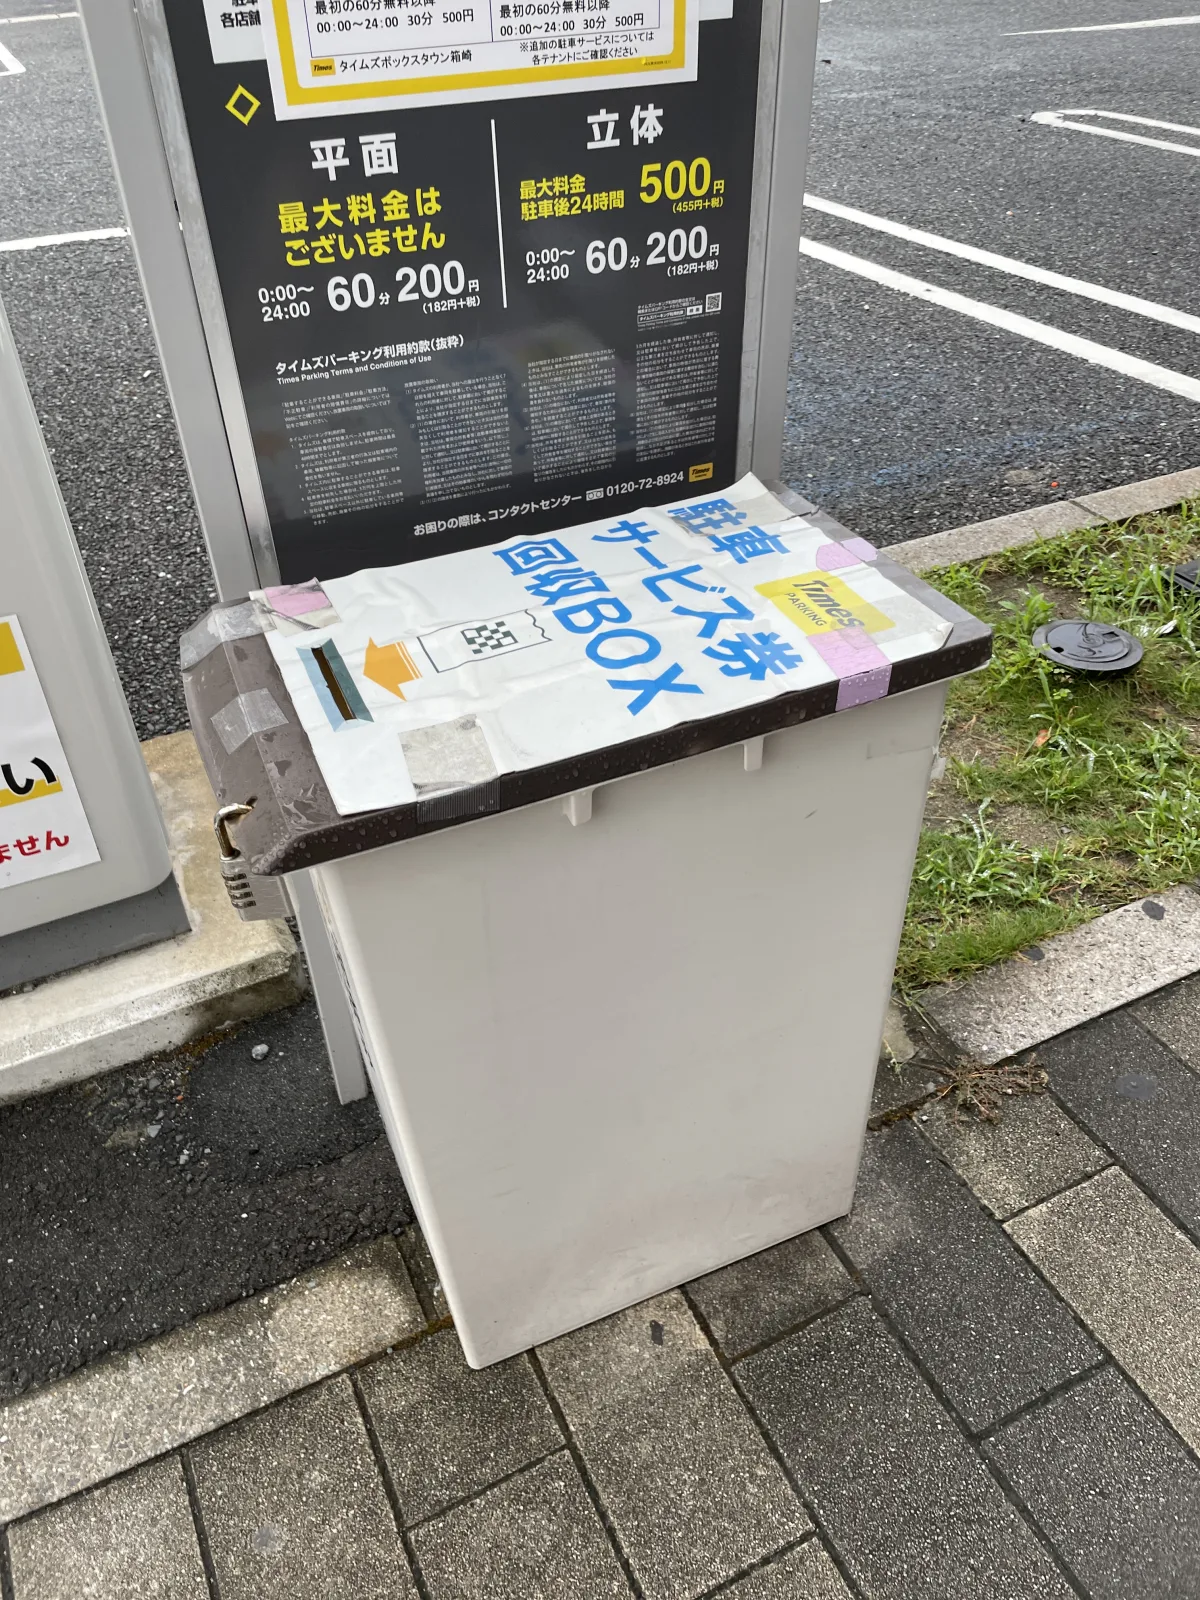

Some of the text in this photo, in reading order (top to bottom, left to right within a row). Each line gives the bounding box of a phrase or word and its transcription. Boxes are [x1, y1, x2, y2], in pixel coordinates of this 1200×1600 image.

[407, 12, 433, 26] 30分
[442, 9, 474, 23] 500円
[583, 15, 607, 30] 30分
[615, 13, 644, 27] 500円
[339, 49, 473, 73] タイムズボックスタウン箱崎
[531, 48, 638, 65] 各テナントにご確認ください
[586, 103, 664, 150] 立体
[309, 132, 399, 182] 平面
[519, 173, 586, 200] 最大料金
[278, 186, 442, 234] 最大料金は
[520, 189, 625, 221] 駐車後24時間
[284, 222, 446, 267] ございません
[526, 263, 570, 284] 24:00
[261, 300, 311, 322] 24:00
[277, 354, 432, 386] Times Parking Terms and Conditions of Use
[413, 471, 684, 536] お困りの際は、コンタクトセンター 0120-72-8924
[667, 498, 791, 564] 駐車
[592, 520, 803, 681] サービス券
[784, 592, 827, 626] PARKING
[792, 580, 865, 627] Times
[492, 539, 704, 716] 回収BOX
[1, 757, 57, 795] い
